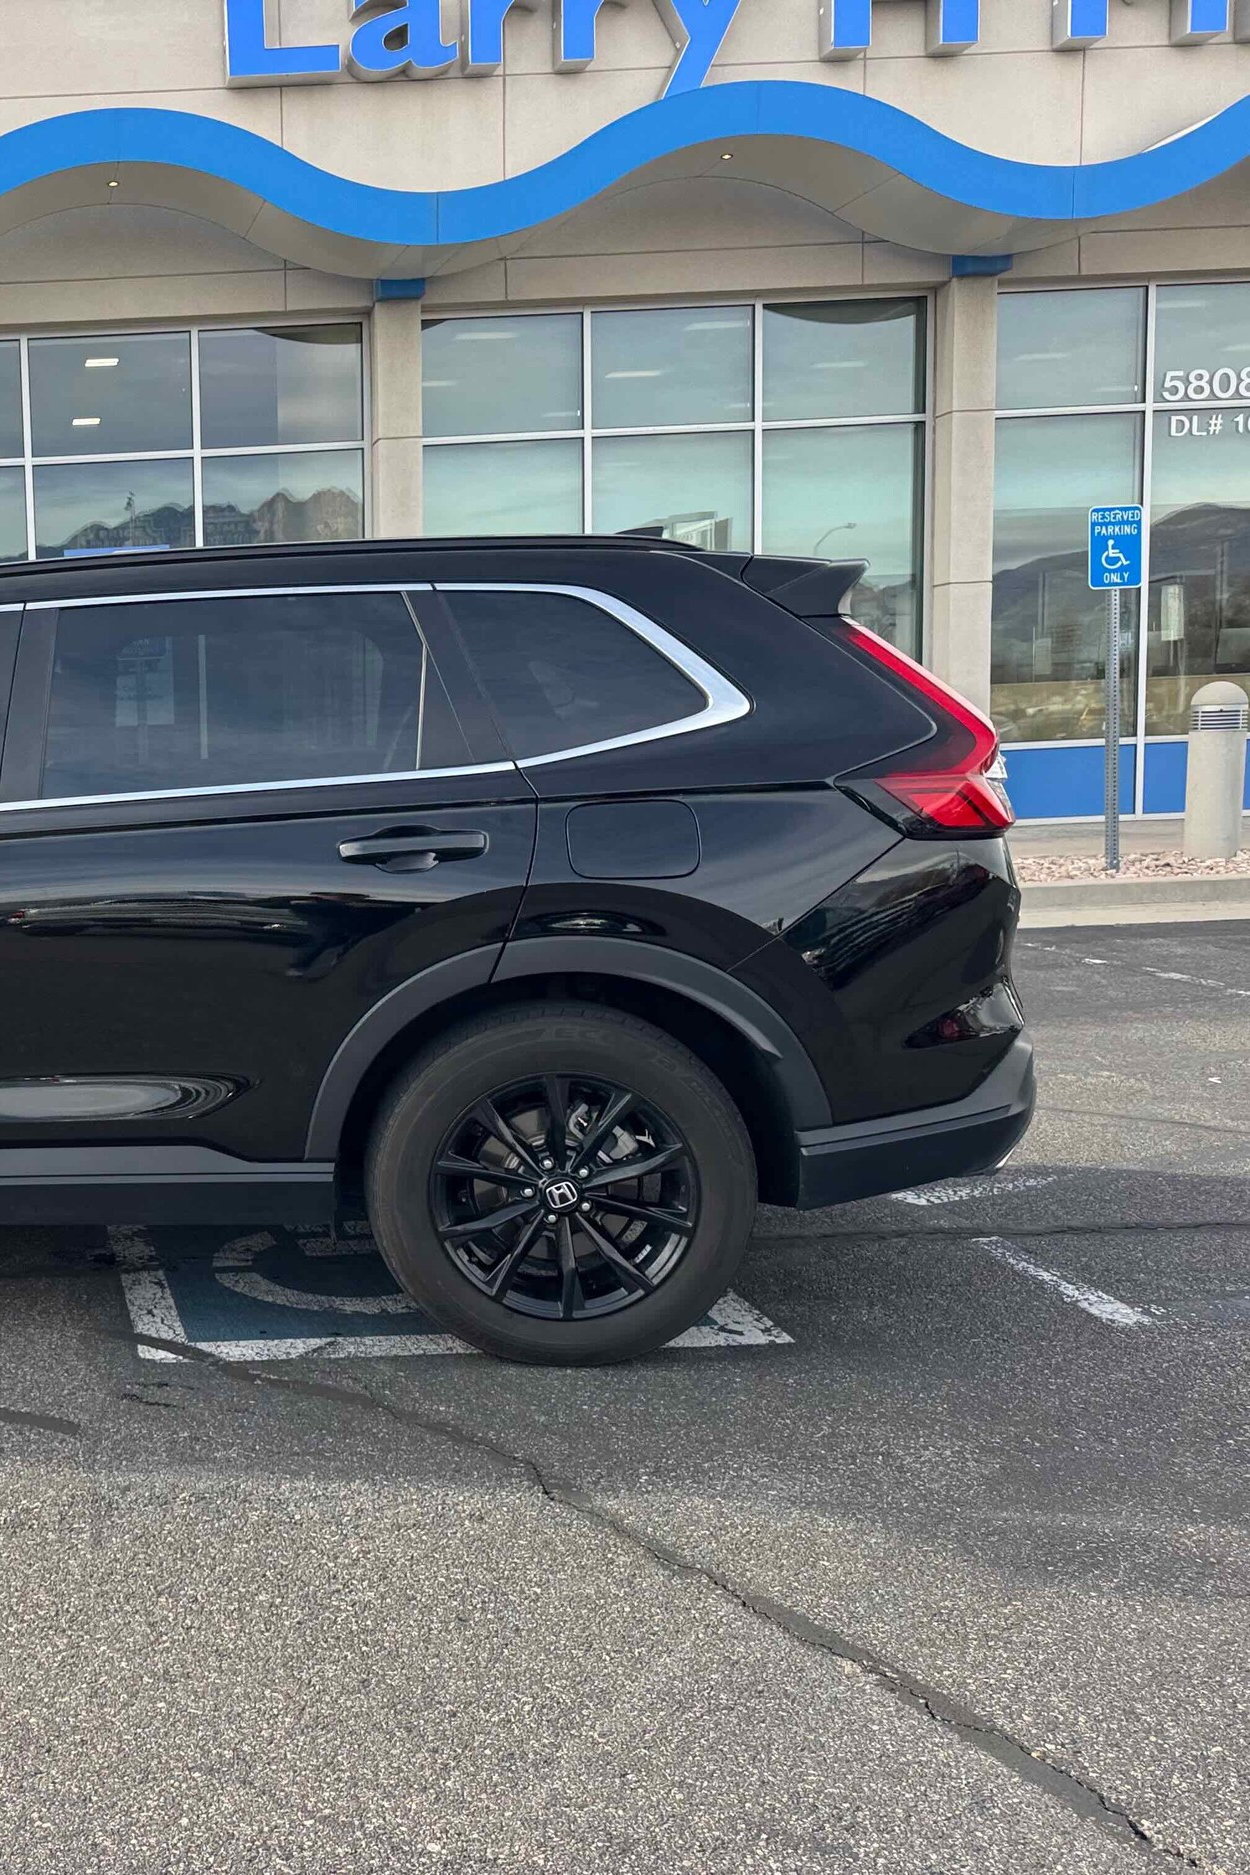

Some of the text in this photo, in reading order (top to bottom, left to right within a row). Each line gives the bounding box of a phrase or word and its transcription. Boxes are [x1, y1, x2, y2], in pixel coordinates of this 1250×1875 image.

[225, 0, 742, 100] Larry
[1170, 413, 1223, 437] DL#
[1091, 510, 1141, 523] RESERVED
[1095, 524, 1138, 536] PARKING
[1103, 572, 1130, 583] ONLY
